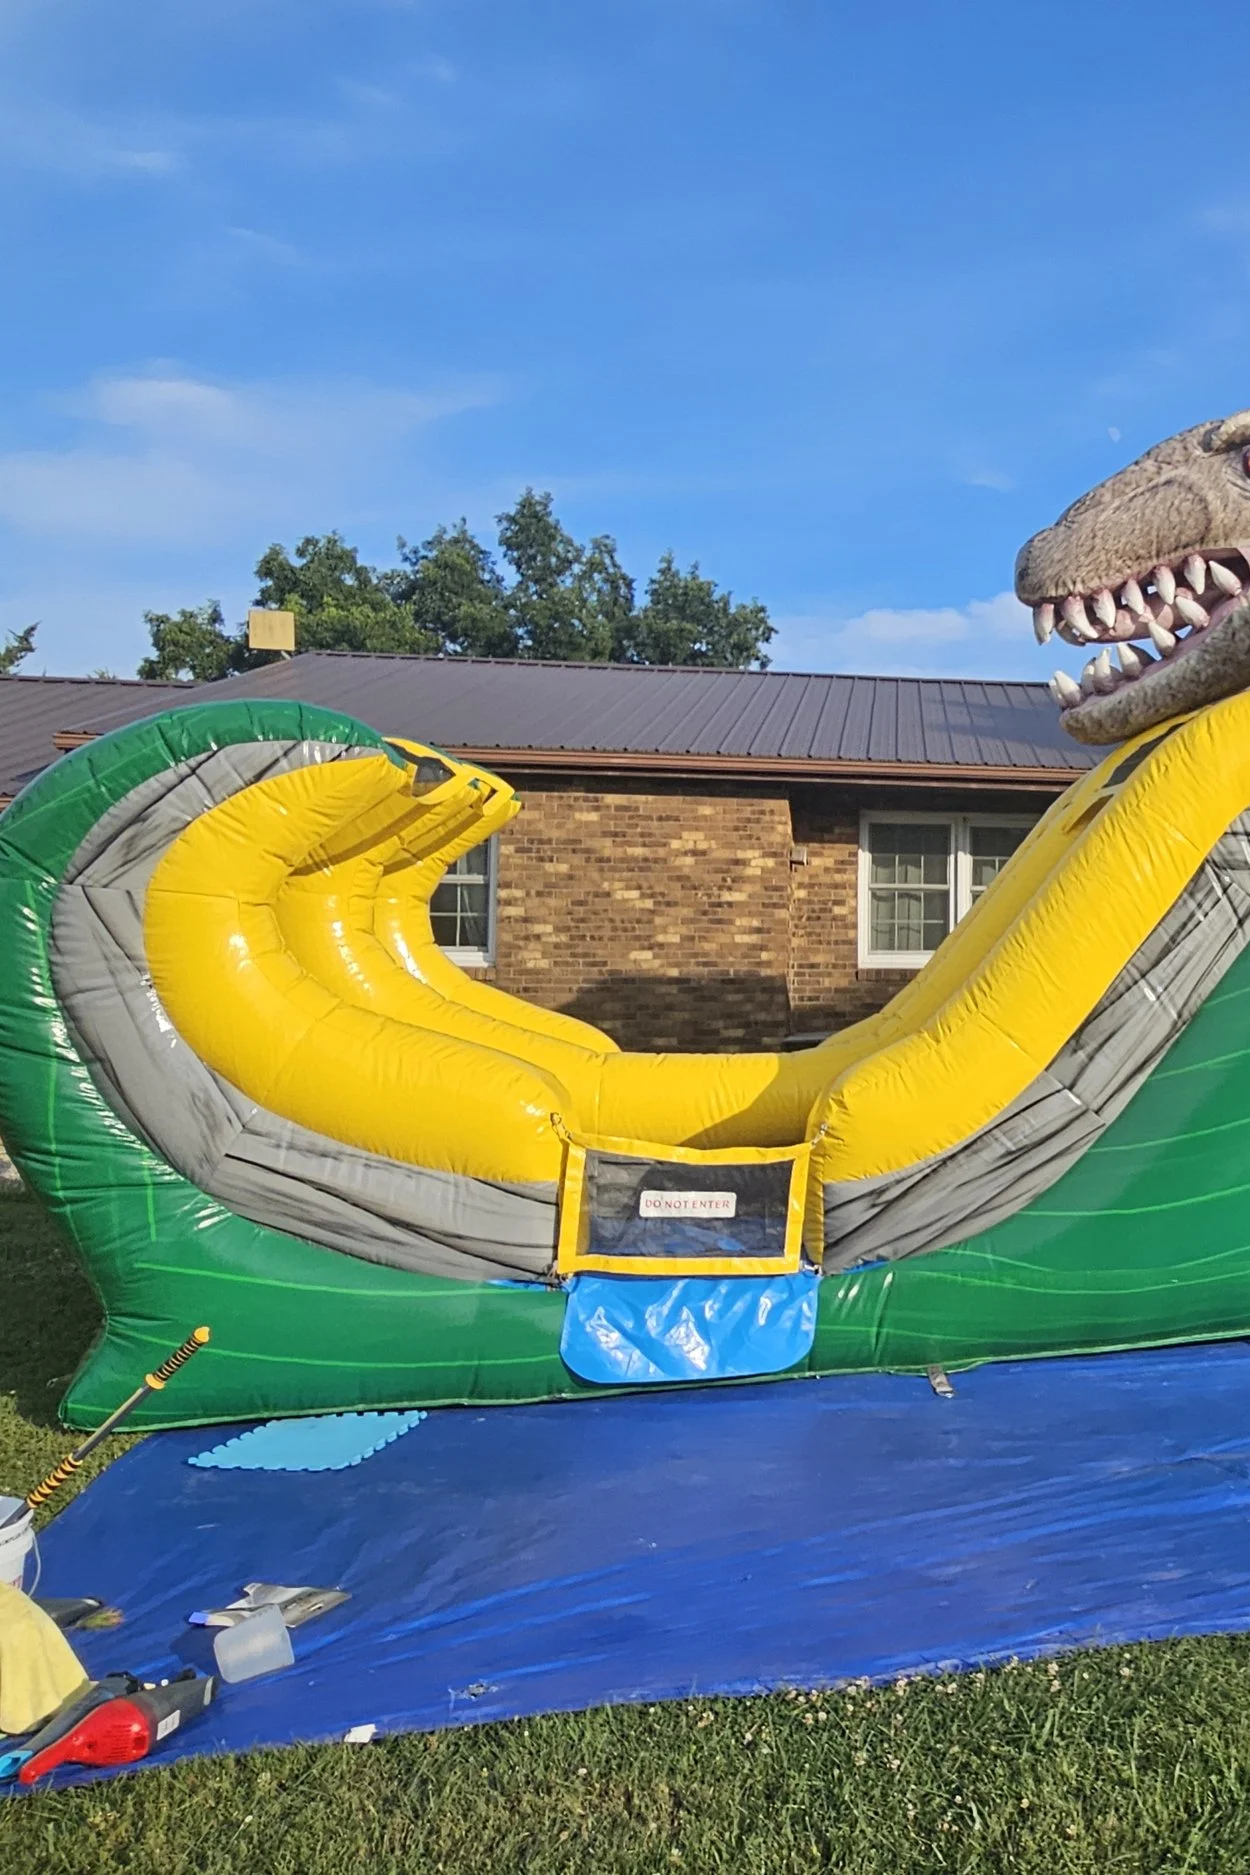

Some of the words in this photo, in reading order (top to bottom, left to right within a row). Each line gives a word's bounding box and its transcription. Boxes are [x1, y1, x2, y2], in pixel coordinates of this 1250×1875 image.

[645, 1199, 661, 1209] DO
[664, 1200, 688, 1209] NOT
[692, 1200, 730, 1209] ENTER
